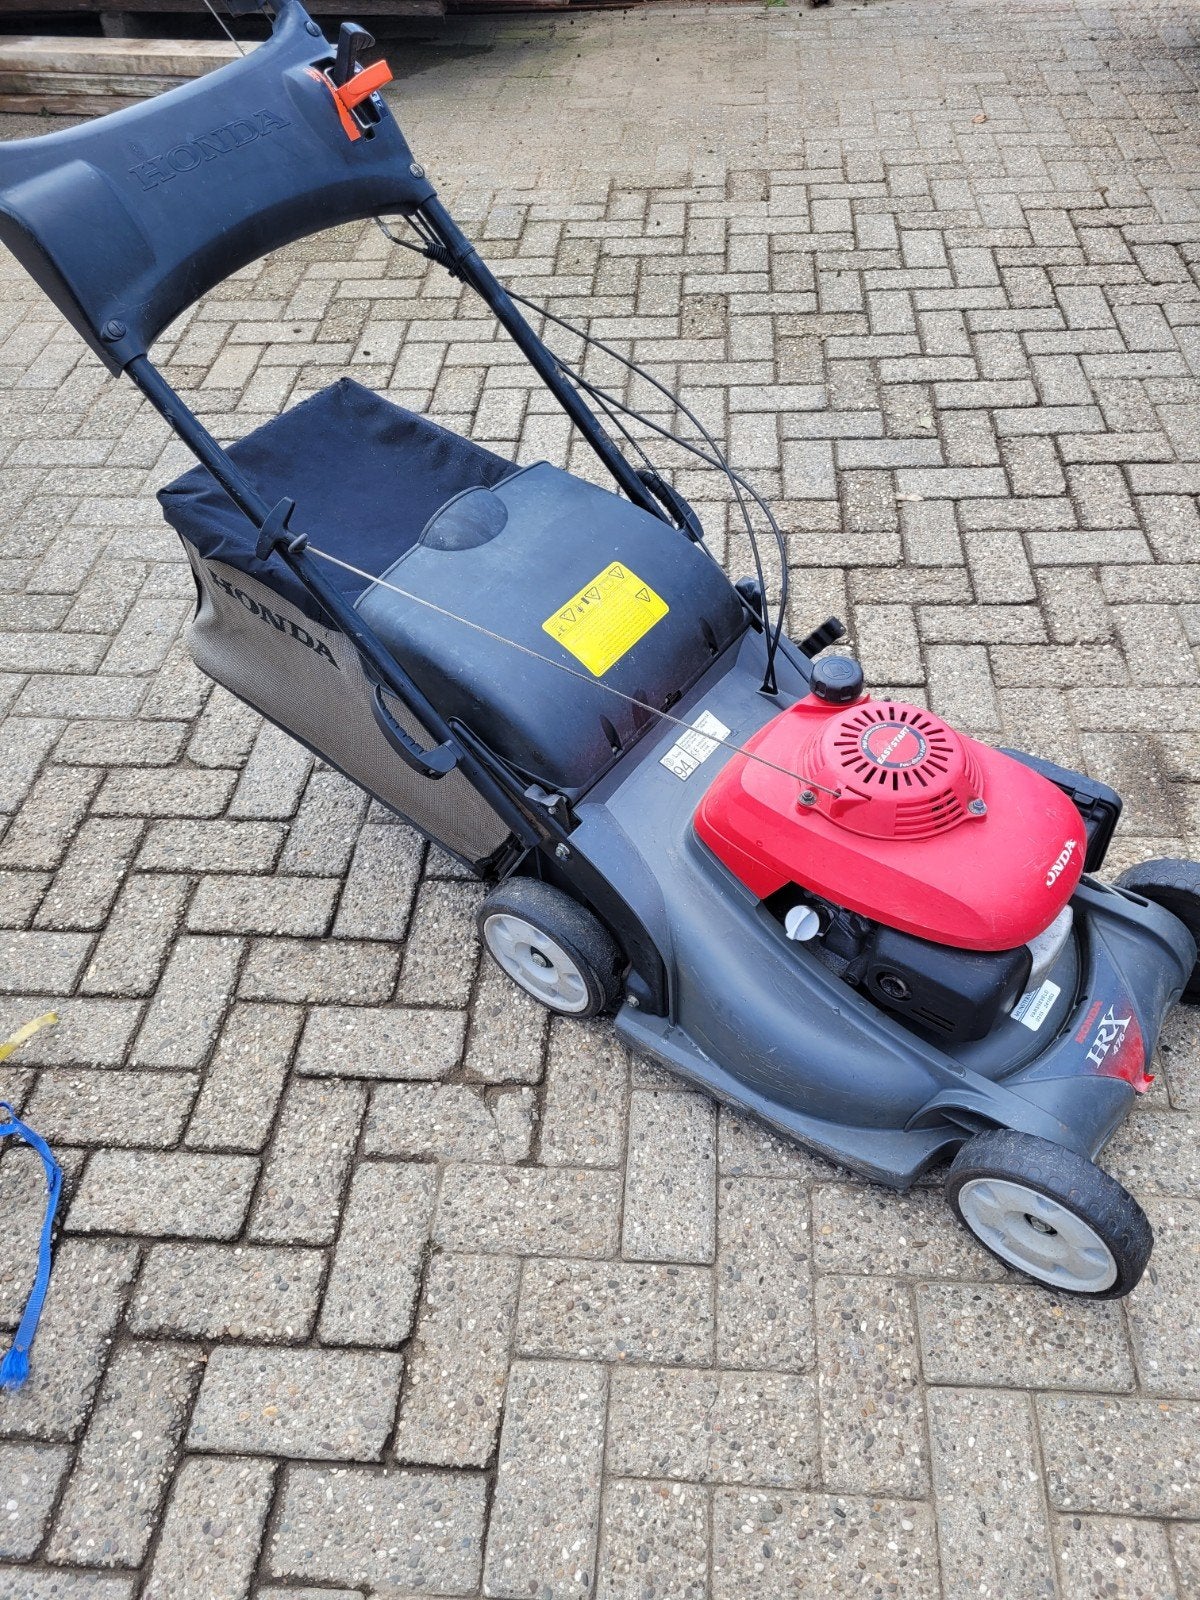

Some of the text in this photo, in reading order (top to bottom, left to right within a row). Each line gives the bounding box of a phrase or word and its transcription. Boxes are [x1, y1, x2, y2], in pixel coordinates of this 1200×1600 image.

[128, 108, 292, 191] HONDA
[207, 567, 341, 671] HONDA
[673, 759, 694, 778] 94
[876, 726, 910, 765] EASY START
[1085, 1004, 1132, 1069] HRX
[1112, 1033, 1125, 1055] 476
